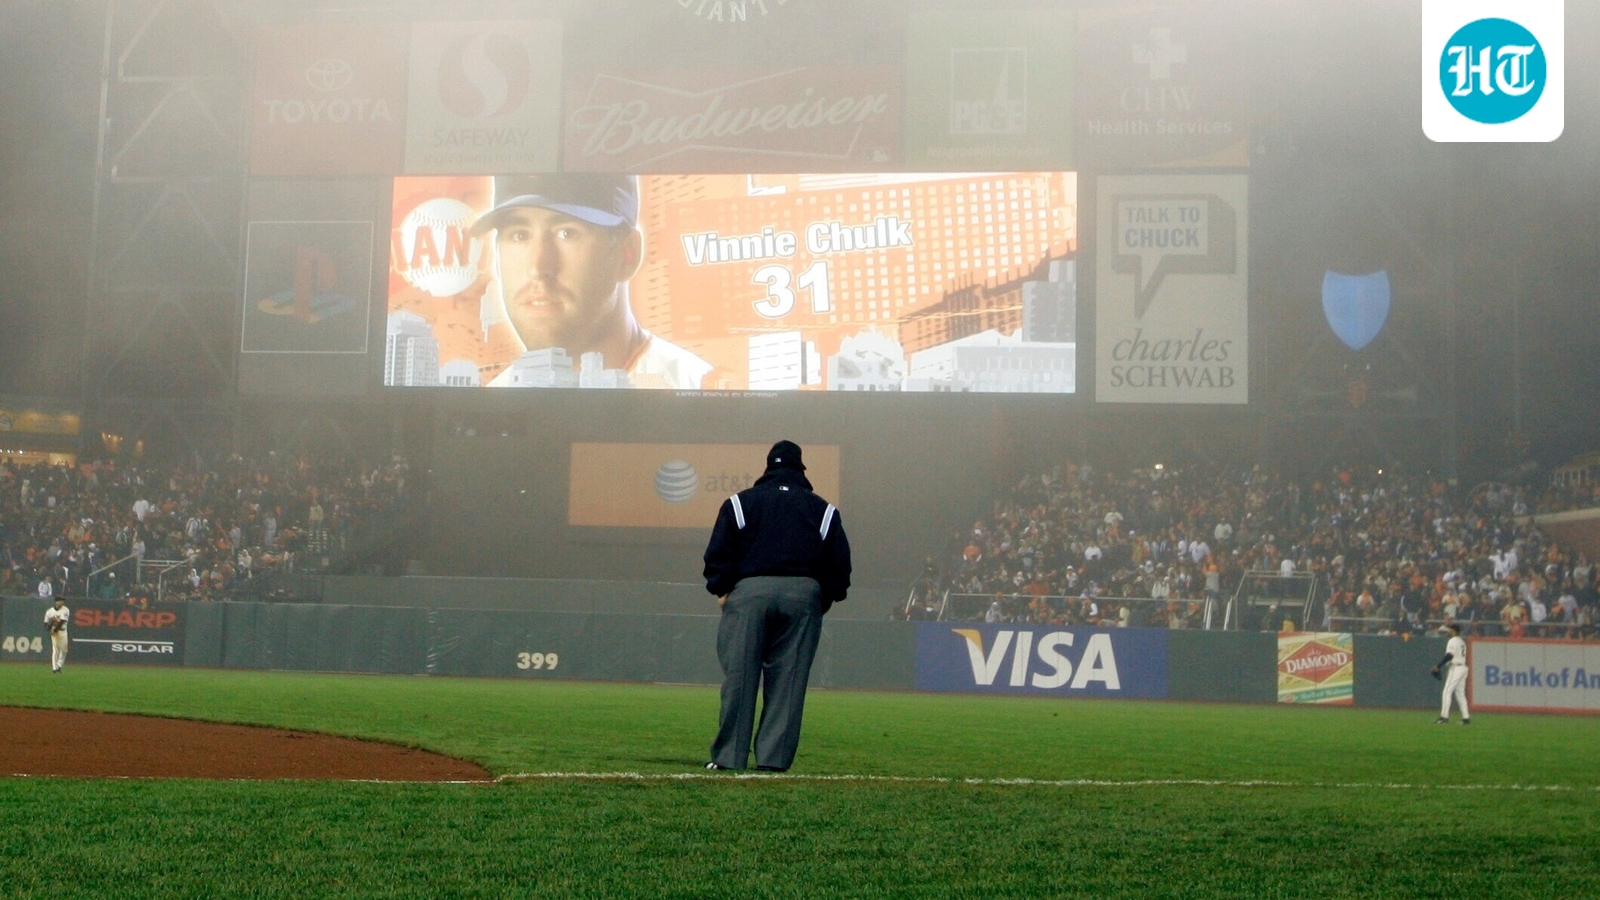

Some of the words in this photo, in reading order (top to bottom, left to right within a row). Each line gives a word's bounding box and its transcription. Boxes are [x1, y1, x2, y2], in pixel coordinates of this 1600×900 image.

[263, 99, 393, 124] TOYOTA
[569, 87, 888, 157] Budweiser
[433, 127, 530, 147] SAFEWAY
[1087, 119, 1150, 136] Health
[1155, 118, 1234, 135] Services
[1125, 206, 1169, 223] TALK
[1178, 206, 1200, 223] TO
[681, 226, 796, 266] Vinnie
[806, 216, 912, 255] Chulk
[1125, 227, 1200, 248] CHUCK
[752, 260, 831, 318] 31
[1112, 328, 1233, 362] charles
[1110, 365, 1235, 388] SCHWAB
[704, 472, 753, 493] at&t
[74, 609, 176, 629] SHARP
[2, 636, 43, 653] 404
[111, 643, 174, 654] SOLAR
[516, 651, 559, 670] 399
[952, 628, 1121, 690] VISA
[1285, 651, 1348, 674] DIAMOND
[1484, 664, 1542, 687] Bank
[1546, 666, 1569, 688] of
